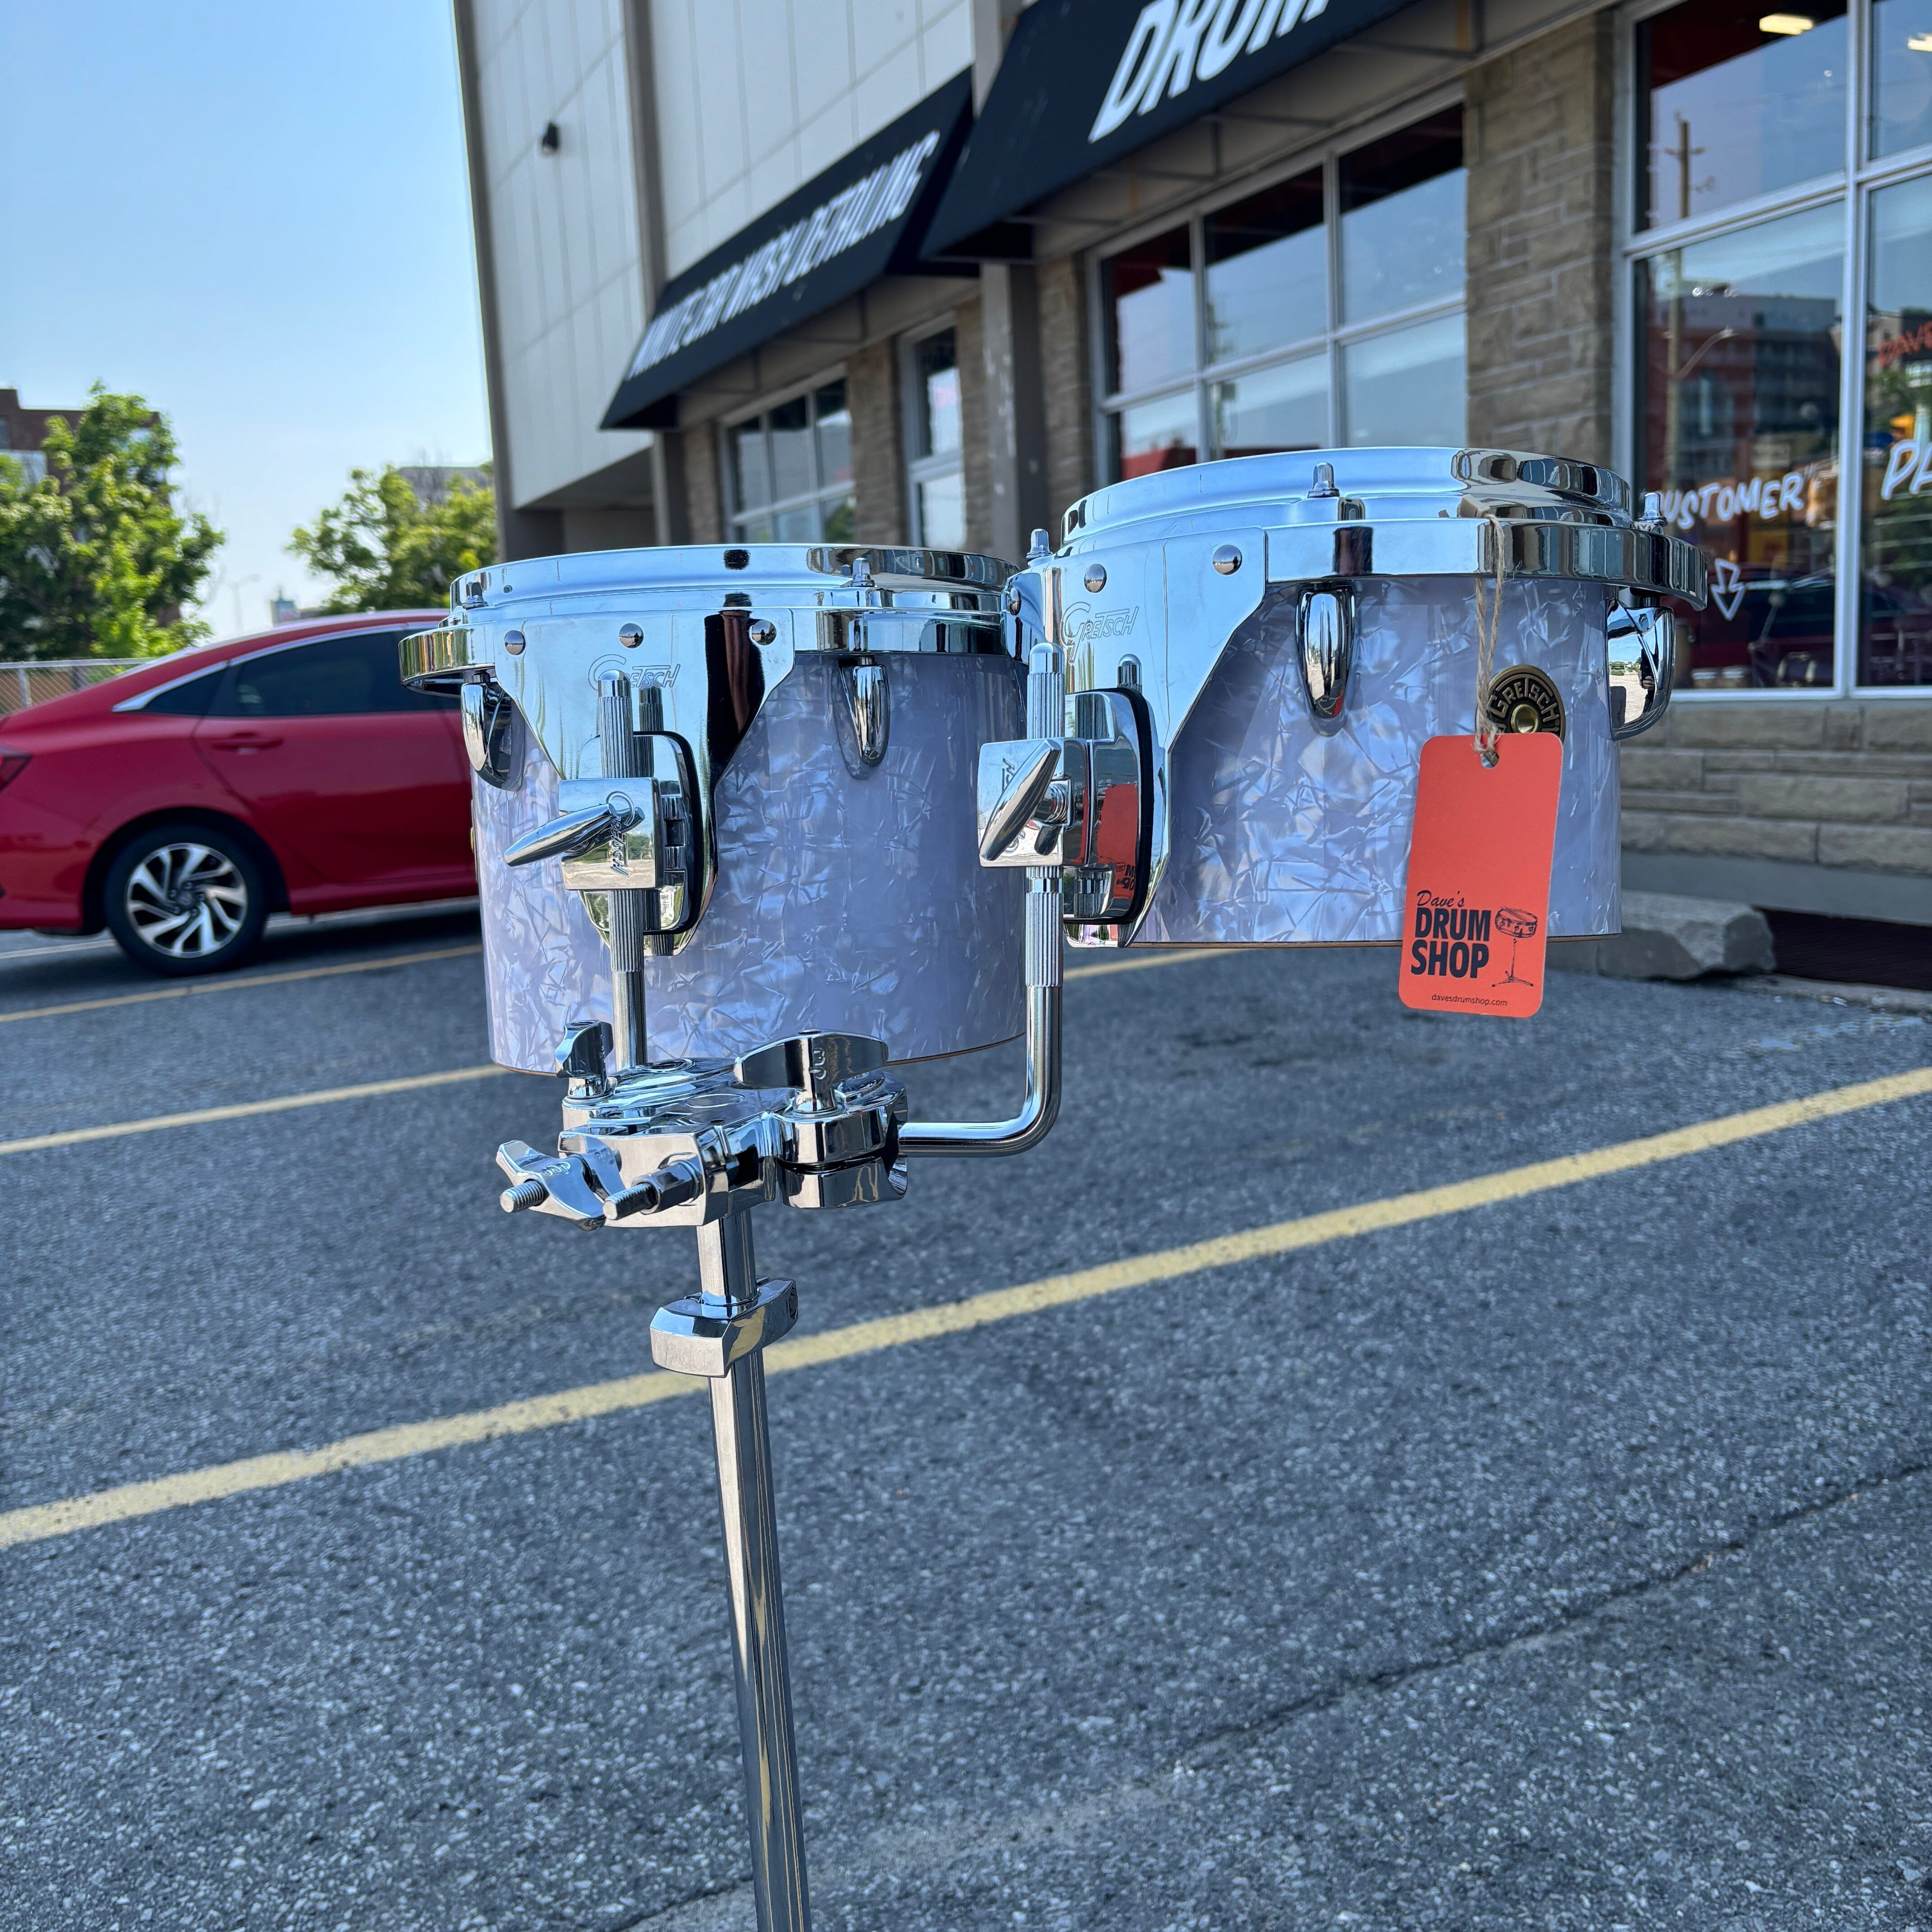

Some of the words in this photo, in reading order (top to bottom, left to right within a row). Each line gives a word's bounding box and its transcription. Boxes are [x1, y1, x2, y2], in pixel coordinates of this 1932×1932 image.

[1651, 471, 1804, 530] USTOMER
[1061, 601, 1139, 663] GRETSCH
[588, 654, 681, 691] GETSCH
[1487, 674, 1559, 722] GRETSCH
[1417, 890, 1465, 907] Dave's
[1414, 907, 1491, 942] DRUM
[1410, 939, 1490, 979] SHOP
[1431, 994, 1508, 1007] davesdrumshop.com
